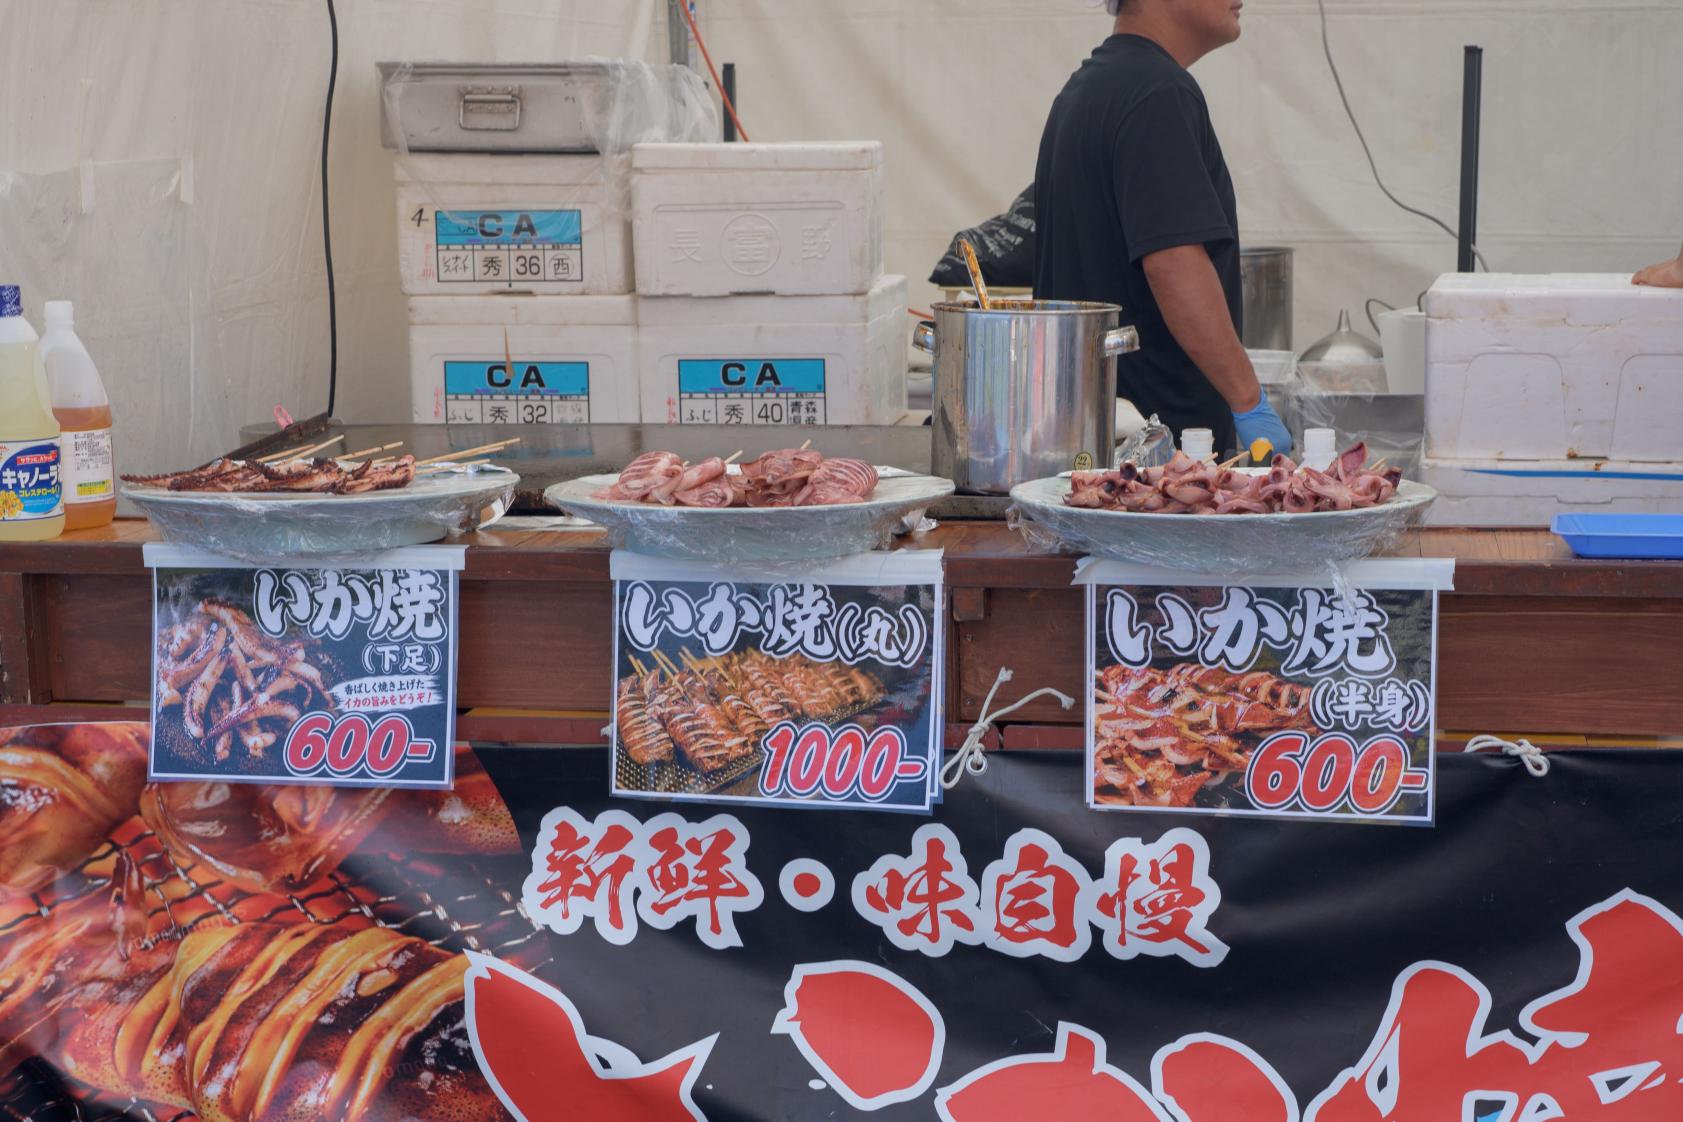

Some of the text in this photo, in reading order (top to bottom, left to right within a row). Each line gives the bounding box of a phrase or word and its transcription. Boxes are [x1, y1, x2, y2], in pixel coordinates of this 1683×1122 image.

[411, 208, 429, 227] 4
[482, 256, 502, 276] 秀
[515, 255, 541, 276] 36
[522, 404, 547, 424] 32
[724, 403, 744, 424] 秀
[757, 402, 783, 424] 40
[2, 464, 62, 490] キャノーラ
[255, 569, 446, 642] いか焼
[1106, 586, 1396, 679] いか焼
[362, 643, 443, 674] (下足)
[344, 678, 426, 695] 香ばしく焼き上げた
[1310, 677, 1431, 732] (半身)
